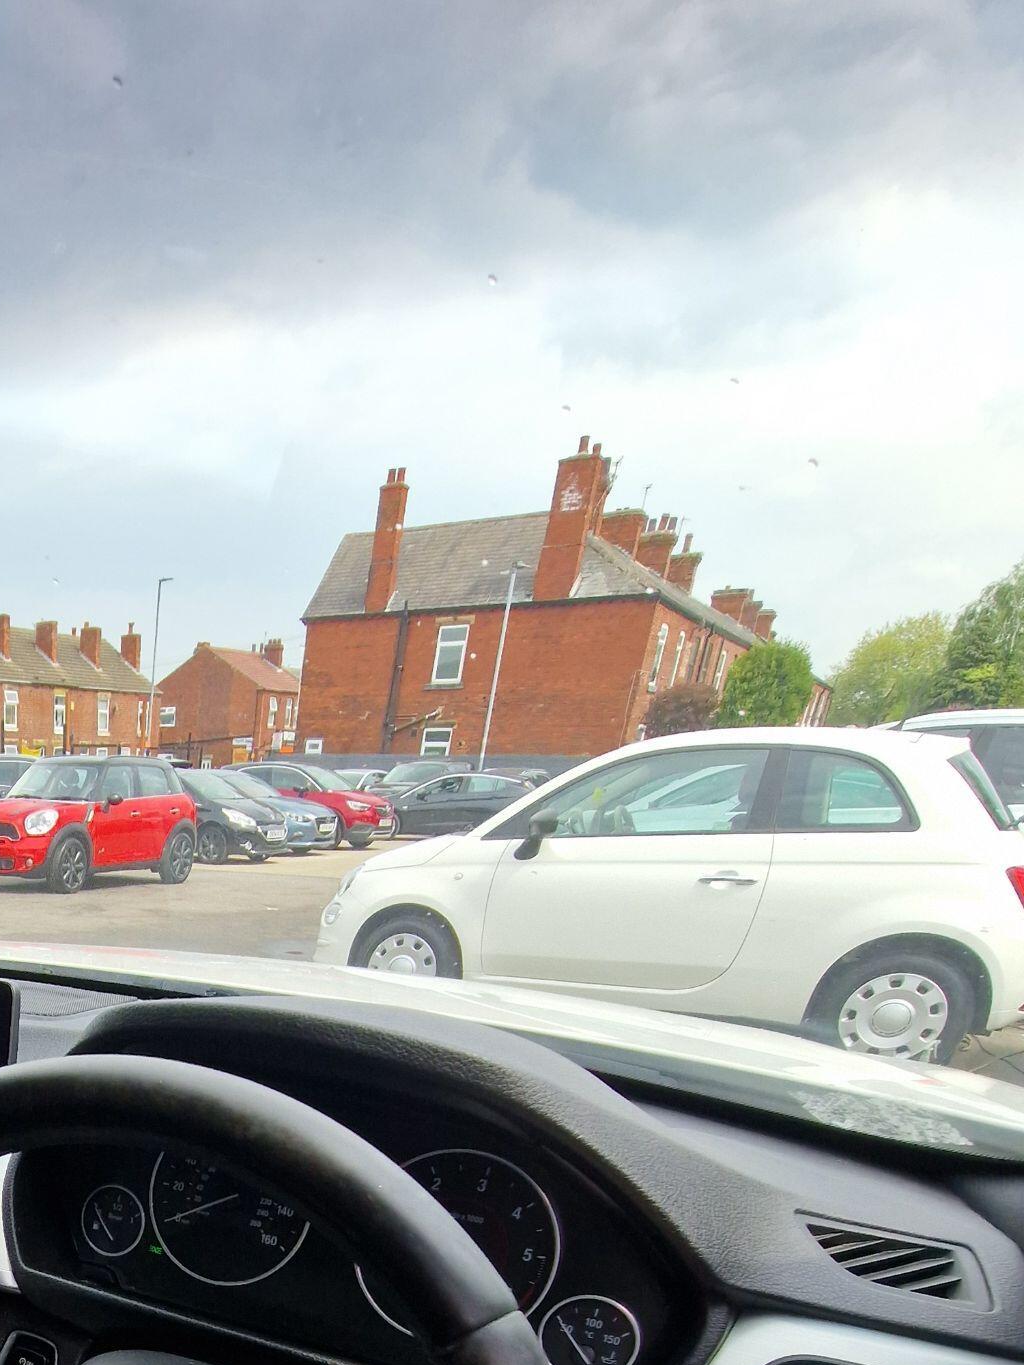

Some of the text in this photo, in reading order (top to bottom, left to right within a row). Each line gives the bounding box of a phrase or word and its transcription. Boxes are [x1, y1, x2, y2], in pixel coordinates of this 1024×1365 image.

[173, 1181, 184, 1192] 20
[277, 1204, 294, 1217] 140
[431, 1177, 533, 1261] 2 3 4 5
[260, 1232, 277, 1246] 160
[585, 1317, 603, 1330] 100
[603, 1334, 621, 1346] 150
